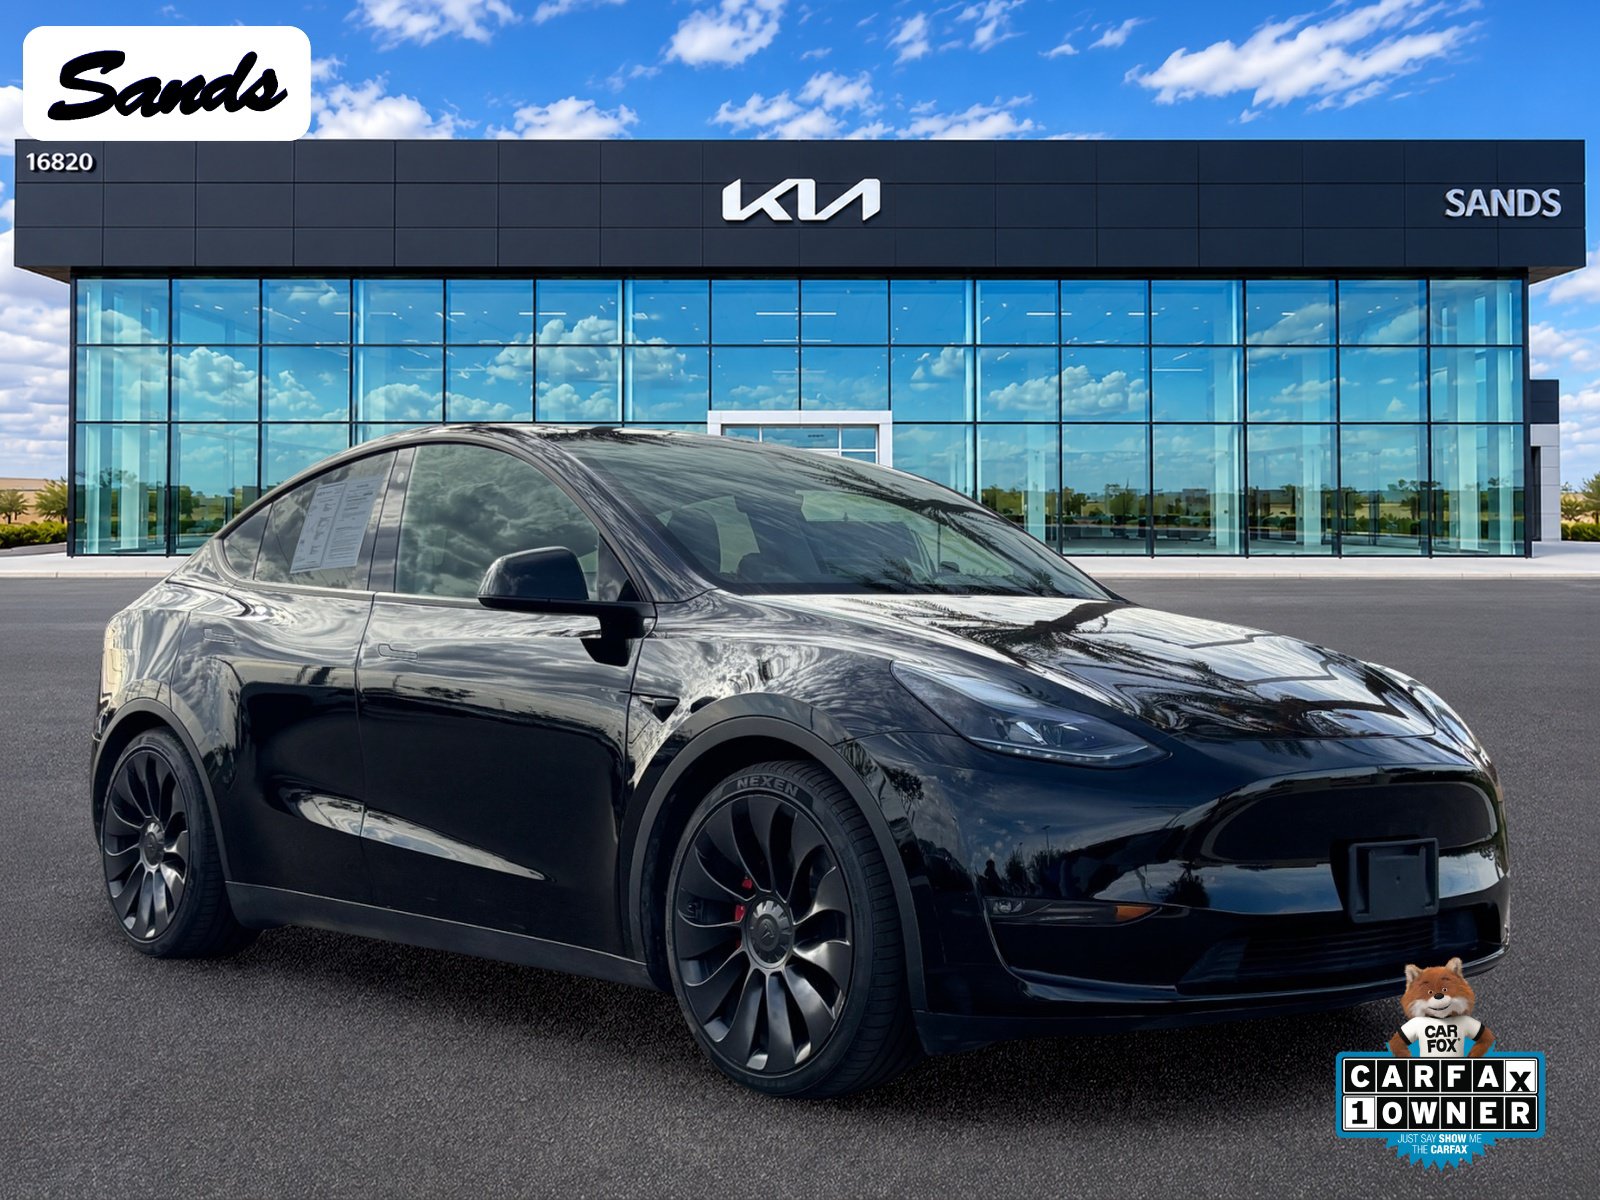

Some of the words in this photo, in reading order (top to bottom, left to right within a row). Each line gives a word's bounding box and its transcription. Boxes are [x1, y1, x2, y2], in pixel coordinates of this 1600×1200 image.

[26, 152, 94, 172] 16820
[1444, 188, 1562, 217] SANDS
[736, 776, 799, 797] NEXEN
